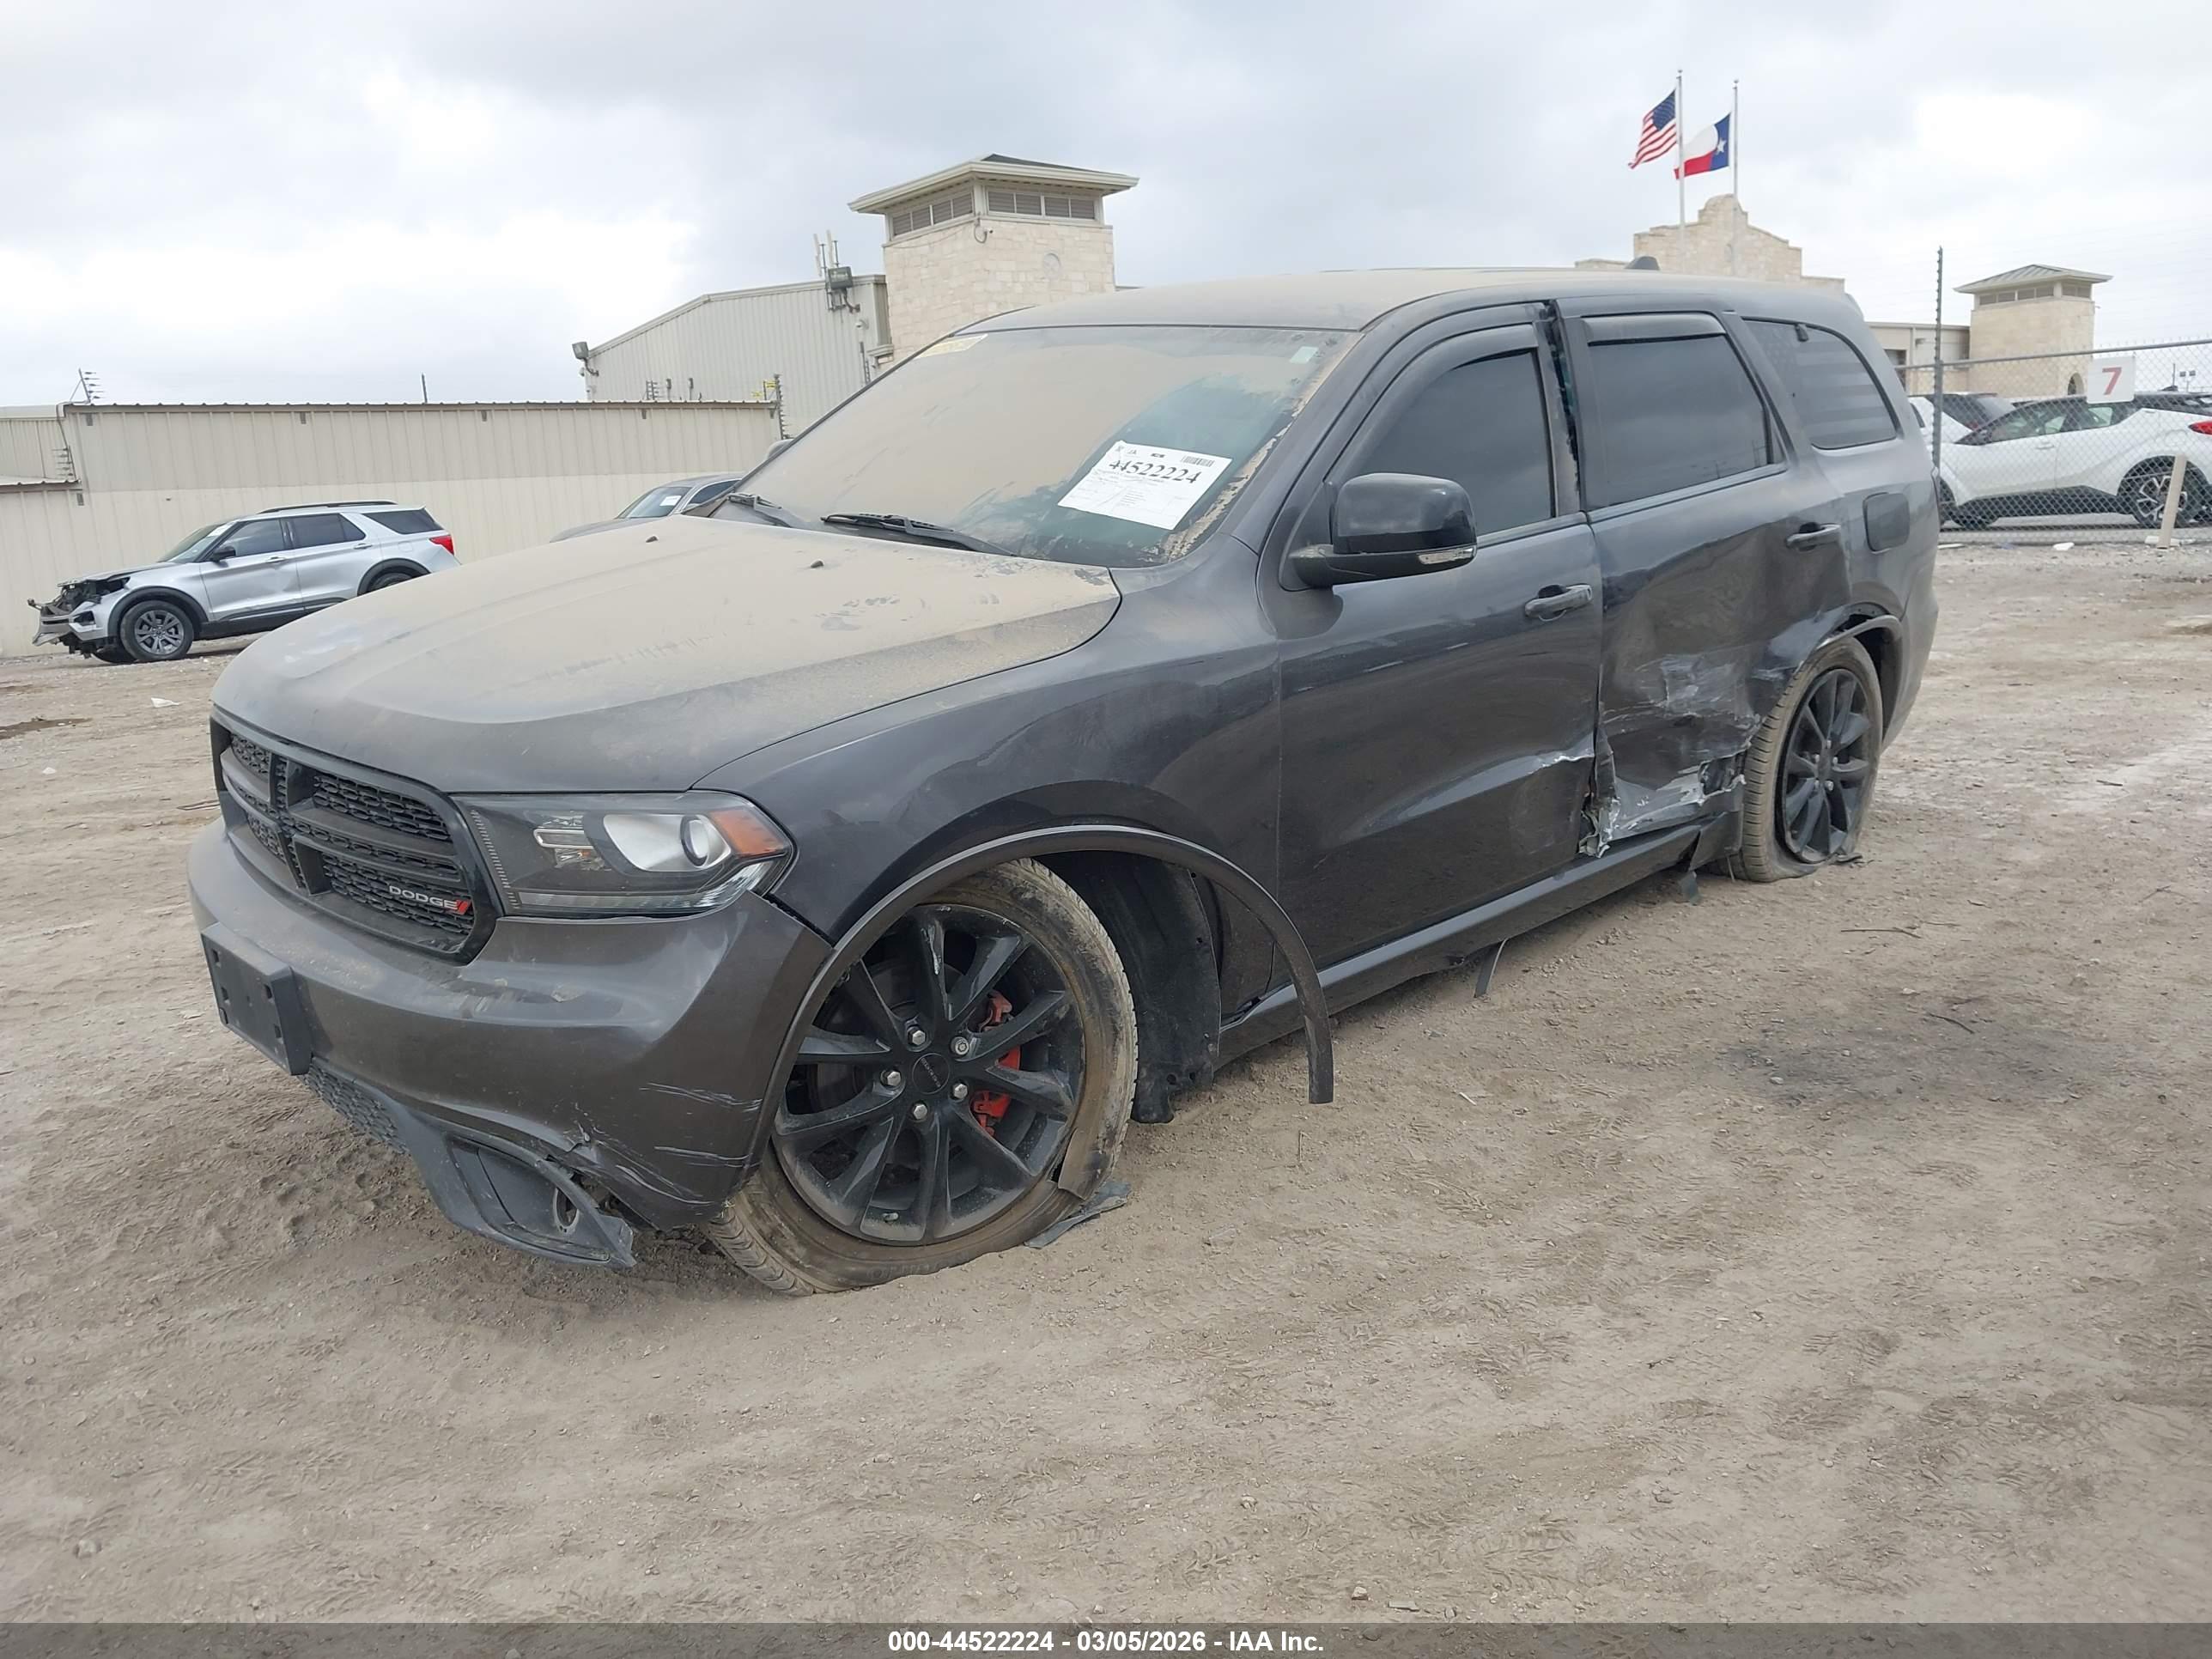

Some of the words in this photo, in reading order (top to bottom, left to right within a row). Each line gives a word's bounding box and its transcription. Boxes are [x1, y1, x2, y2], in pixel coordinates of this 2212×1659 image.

[2101, 367, 2123, 395] 7
[1109, 459, 1202, 484] 44522224
[389, 885, 459, 910] DODGE
